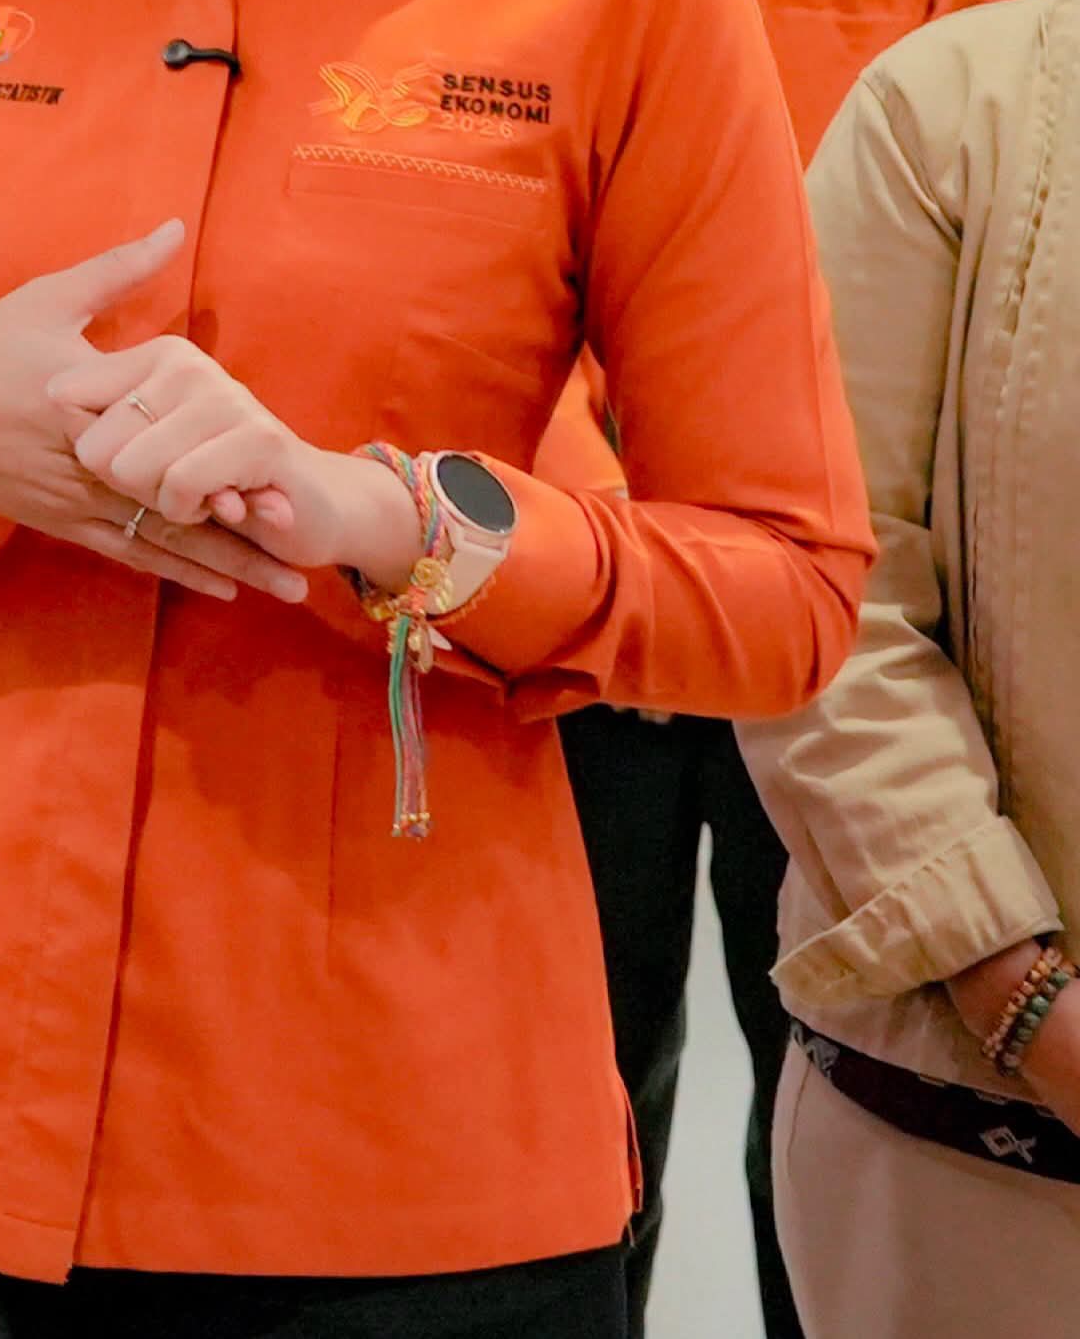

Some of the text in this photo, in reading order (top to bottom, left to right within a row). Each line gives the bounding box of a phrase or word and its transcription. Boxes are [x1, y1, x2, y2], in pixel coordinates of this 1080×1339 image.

[442, 73, 552, 102] SENSUS
[439, 94, 551, 125] EKONOMI
[439, 113, 513, 139] 2026
